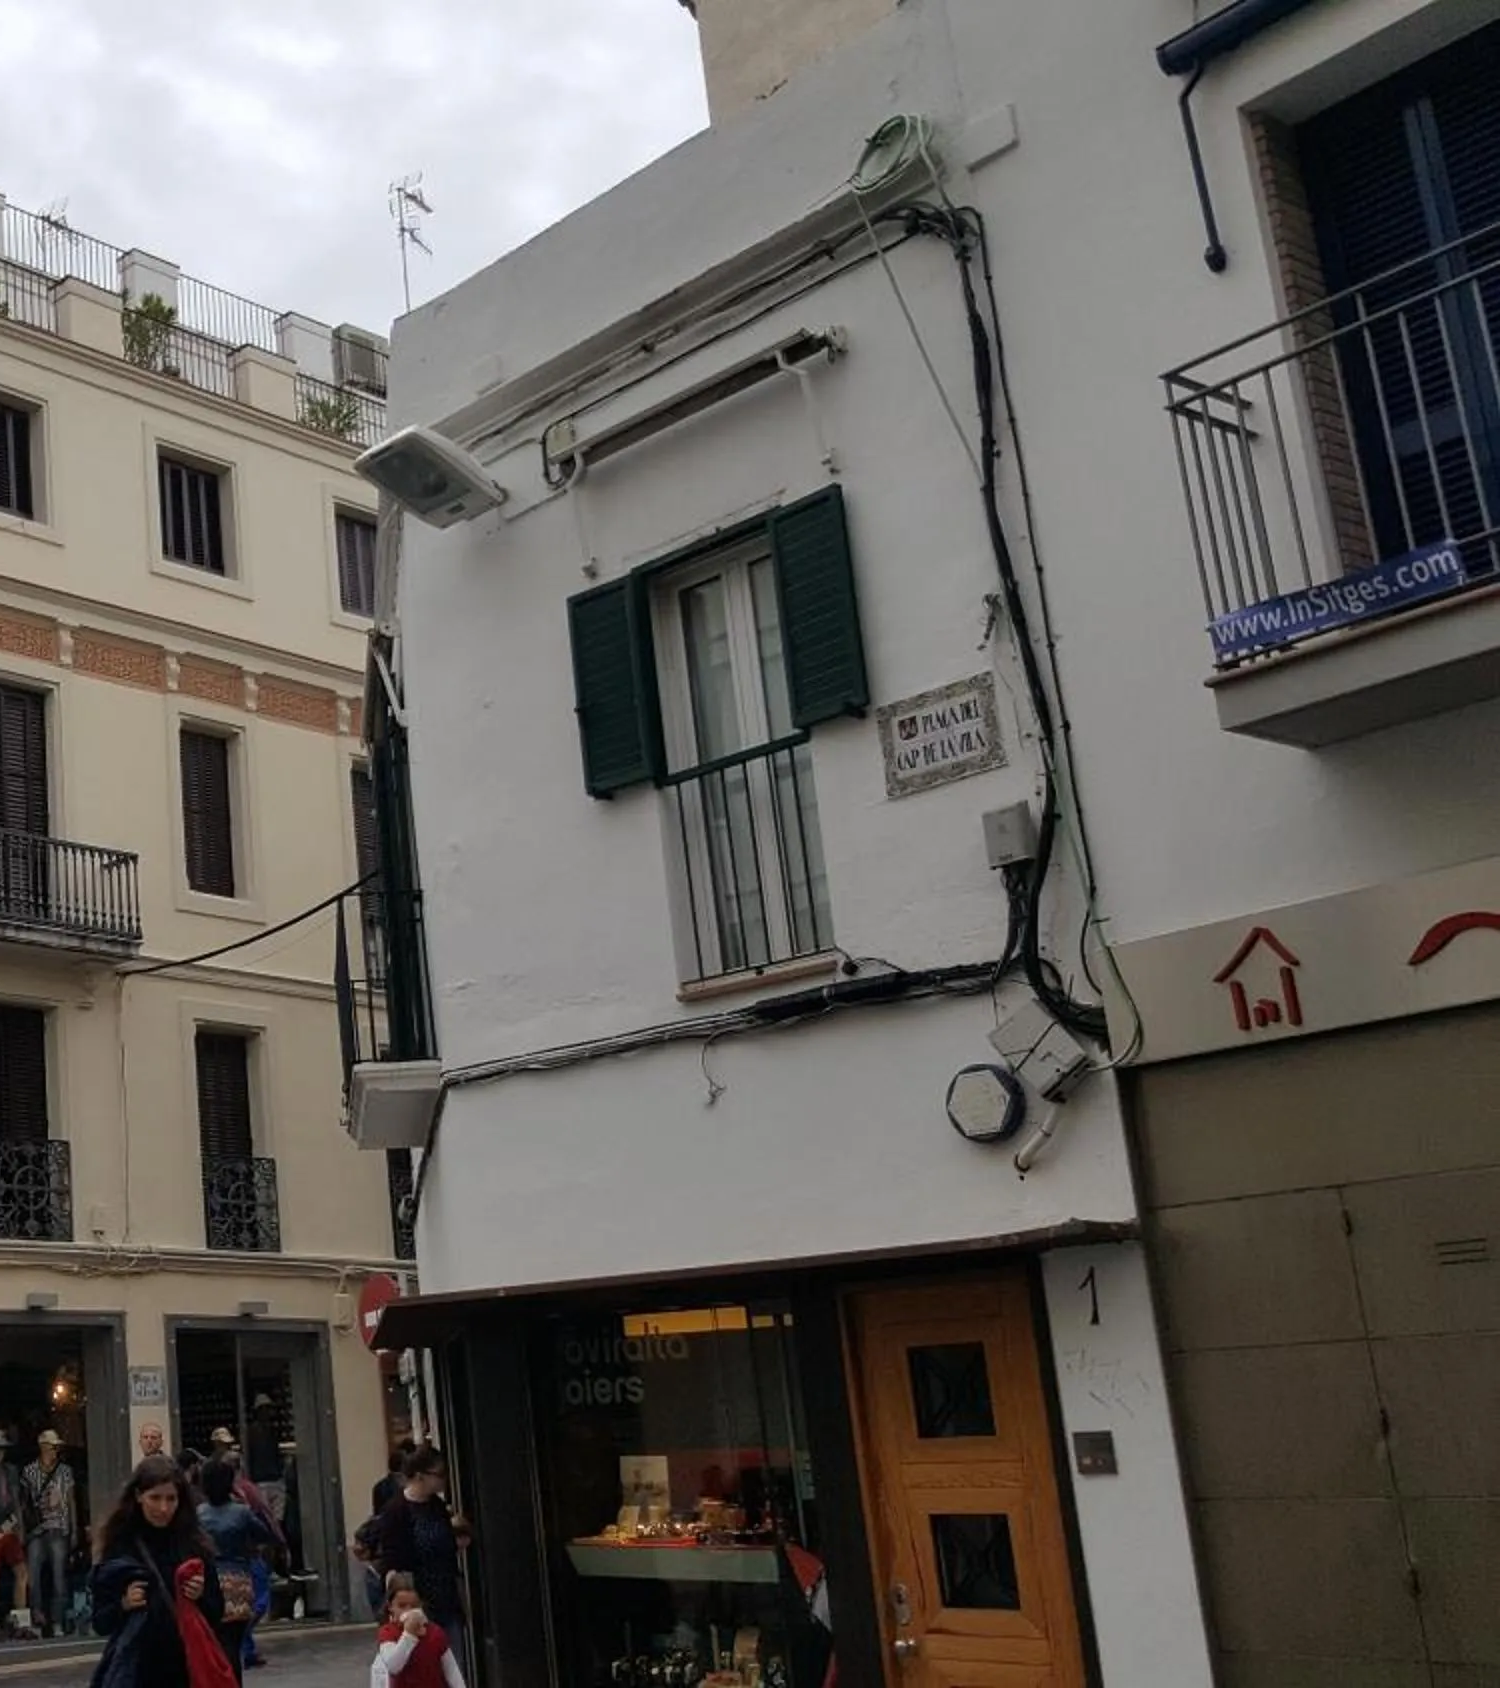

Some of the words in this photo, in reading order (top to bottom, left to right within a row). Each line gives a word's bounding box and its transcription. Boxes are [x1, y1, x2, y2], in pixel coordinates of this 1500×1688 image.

[1214, 550, 1460, 646] www.InSitges.com
[897, 749, 919, 771] CAP
[922, 741, 937, 765] DE
[940, 736, 958, 760] LA
[563, 1321, 690, 1365] oviralta
[563, 1368, 645, 1407] oiers
